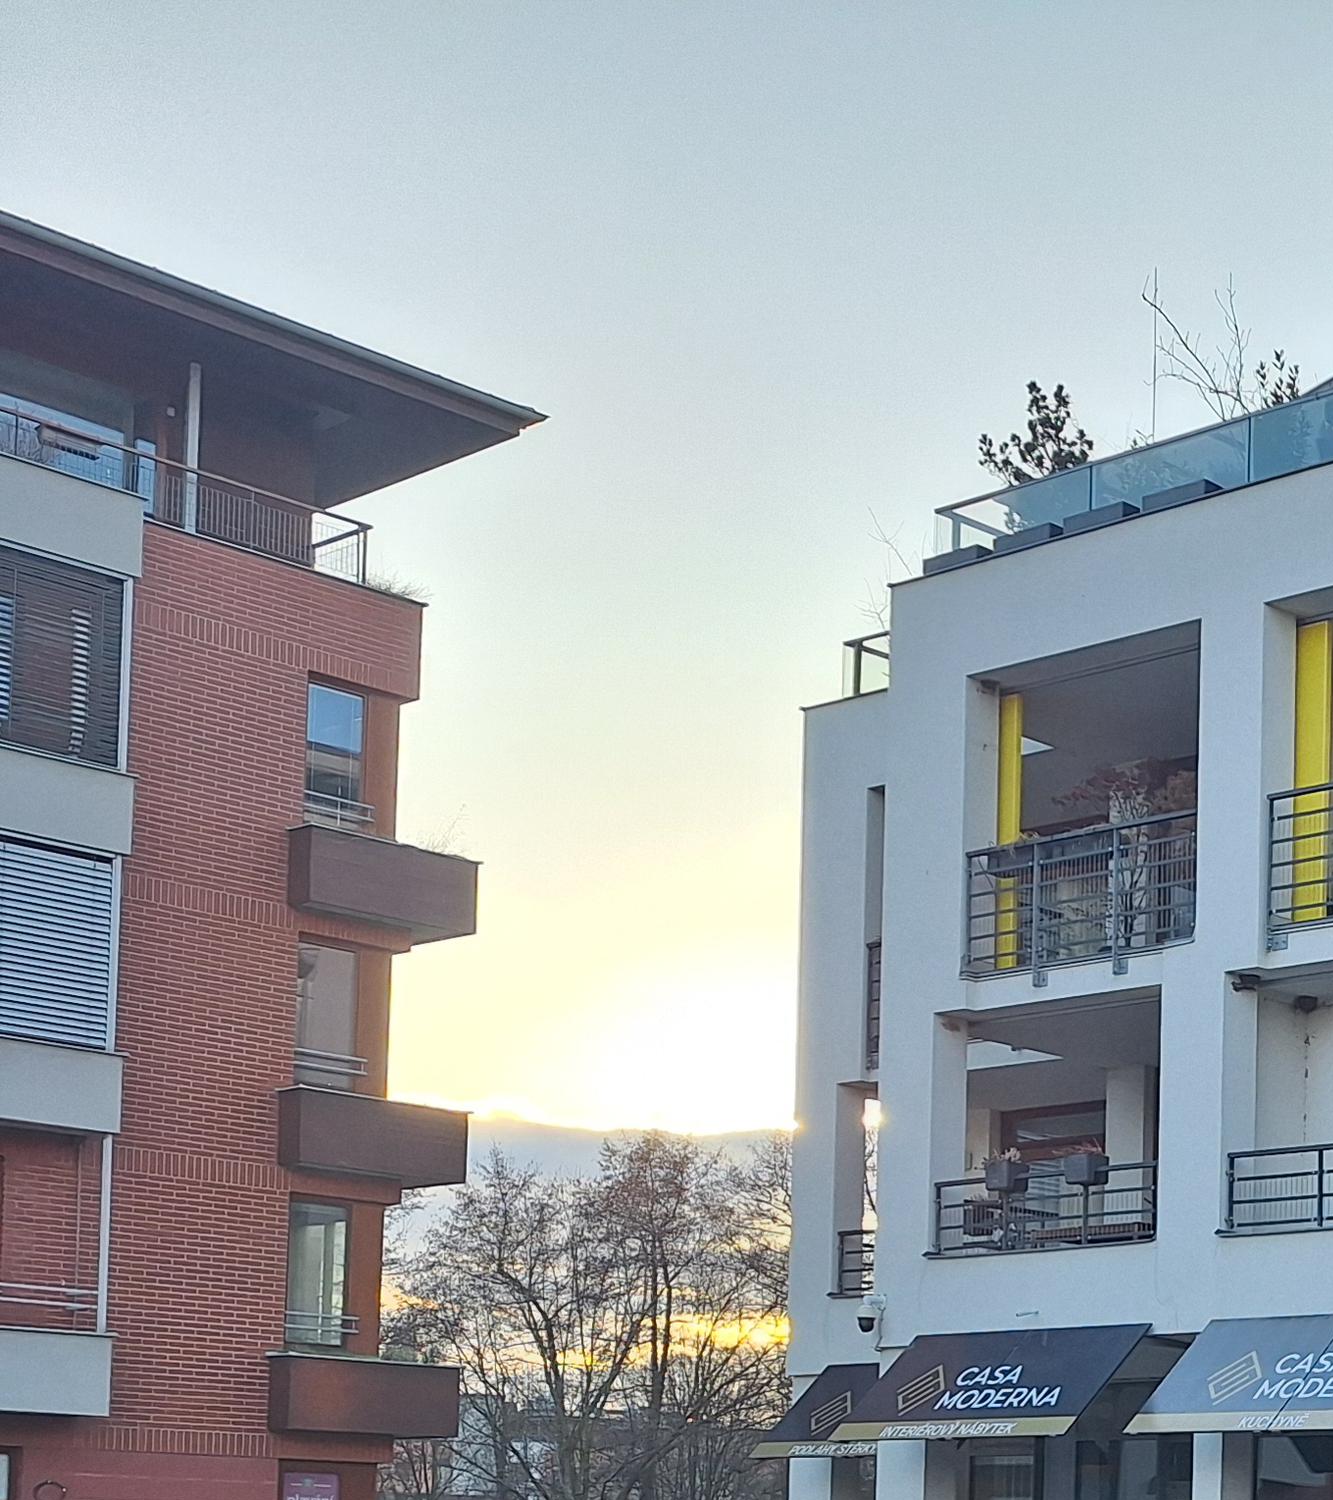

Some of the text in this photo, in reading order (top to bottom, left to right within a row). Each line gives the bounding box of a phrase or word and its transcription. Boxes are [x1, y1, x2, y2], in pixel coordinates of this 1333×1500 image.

[955, 1365, 1023, 1386] CASA
[933, 1386, 1061, 1410] MODERNA
[1238, 1412, 1310, 1428] KUCHYNĚ
[880, 1421, 1018, 1438] INTERIÉROVÝ NÁBYTEK
[787, 1443, 837, 1456] PODLAHY
